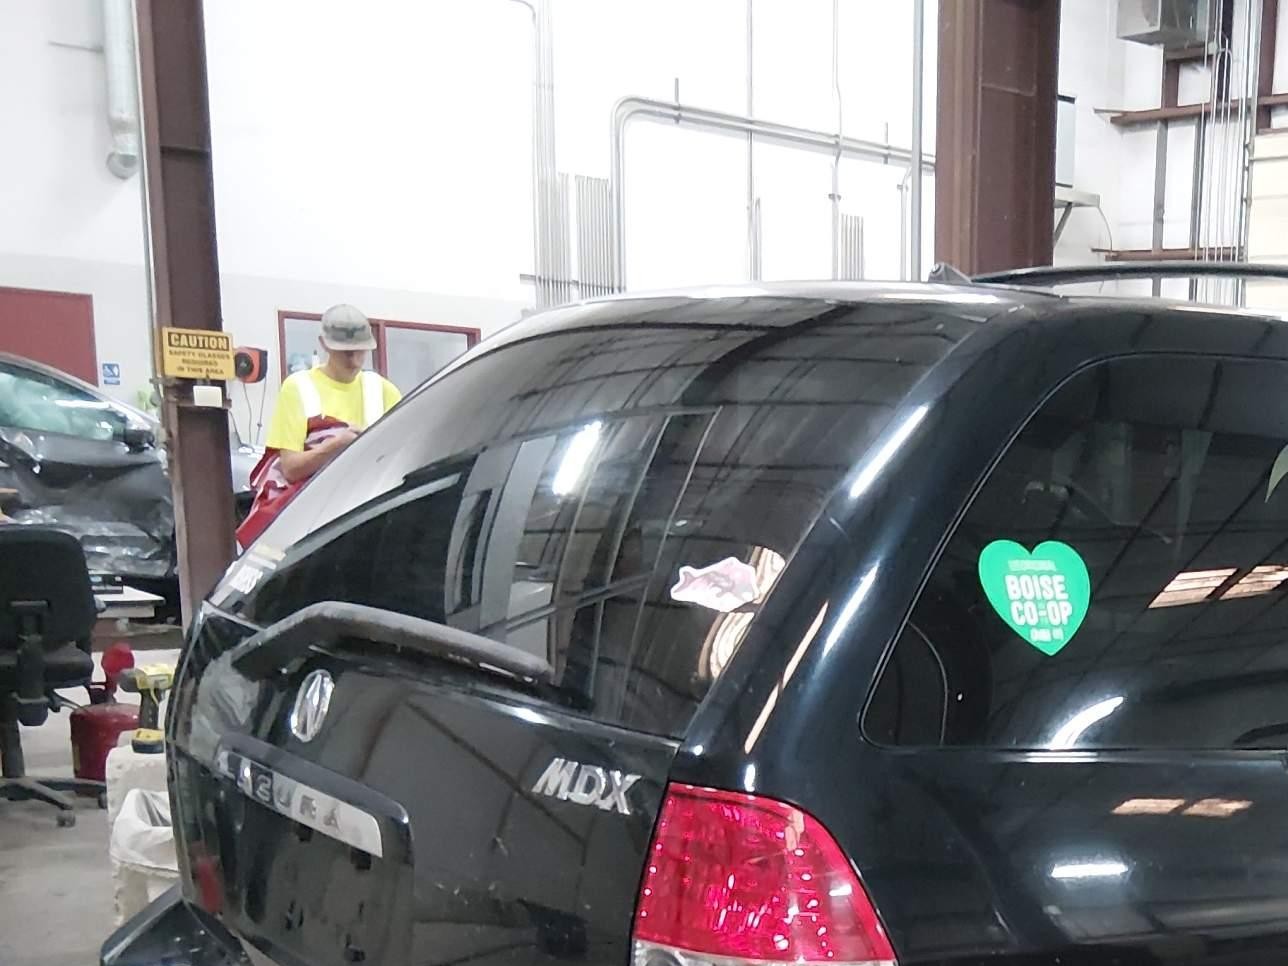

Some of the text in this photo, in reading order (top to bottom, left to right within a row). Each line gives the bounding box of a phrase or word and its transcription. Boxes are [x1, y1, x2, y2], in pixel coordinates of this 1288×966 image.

[170, 333, 227, 350] CAUTION
[1005, 574, 1069, 601] BOISE
[1010, 600, 1073, 626] CO-OP
[531, 757, 642, 815] MDX
